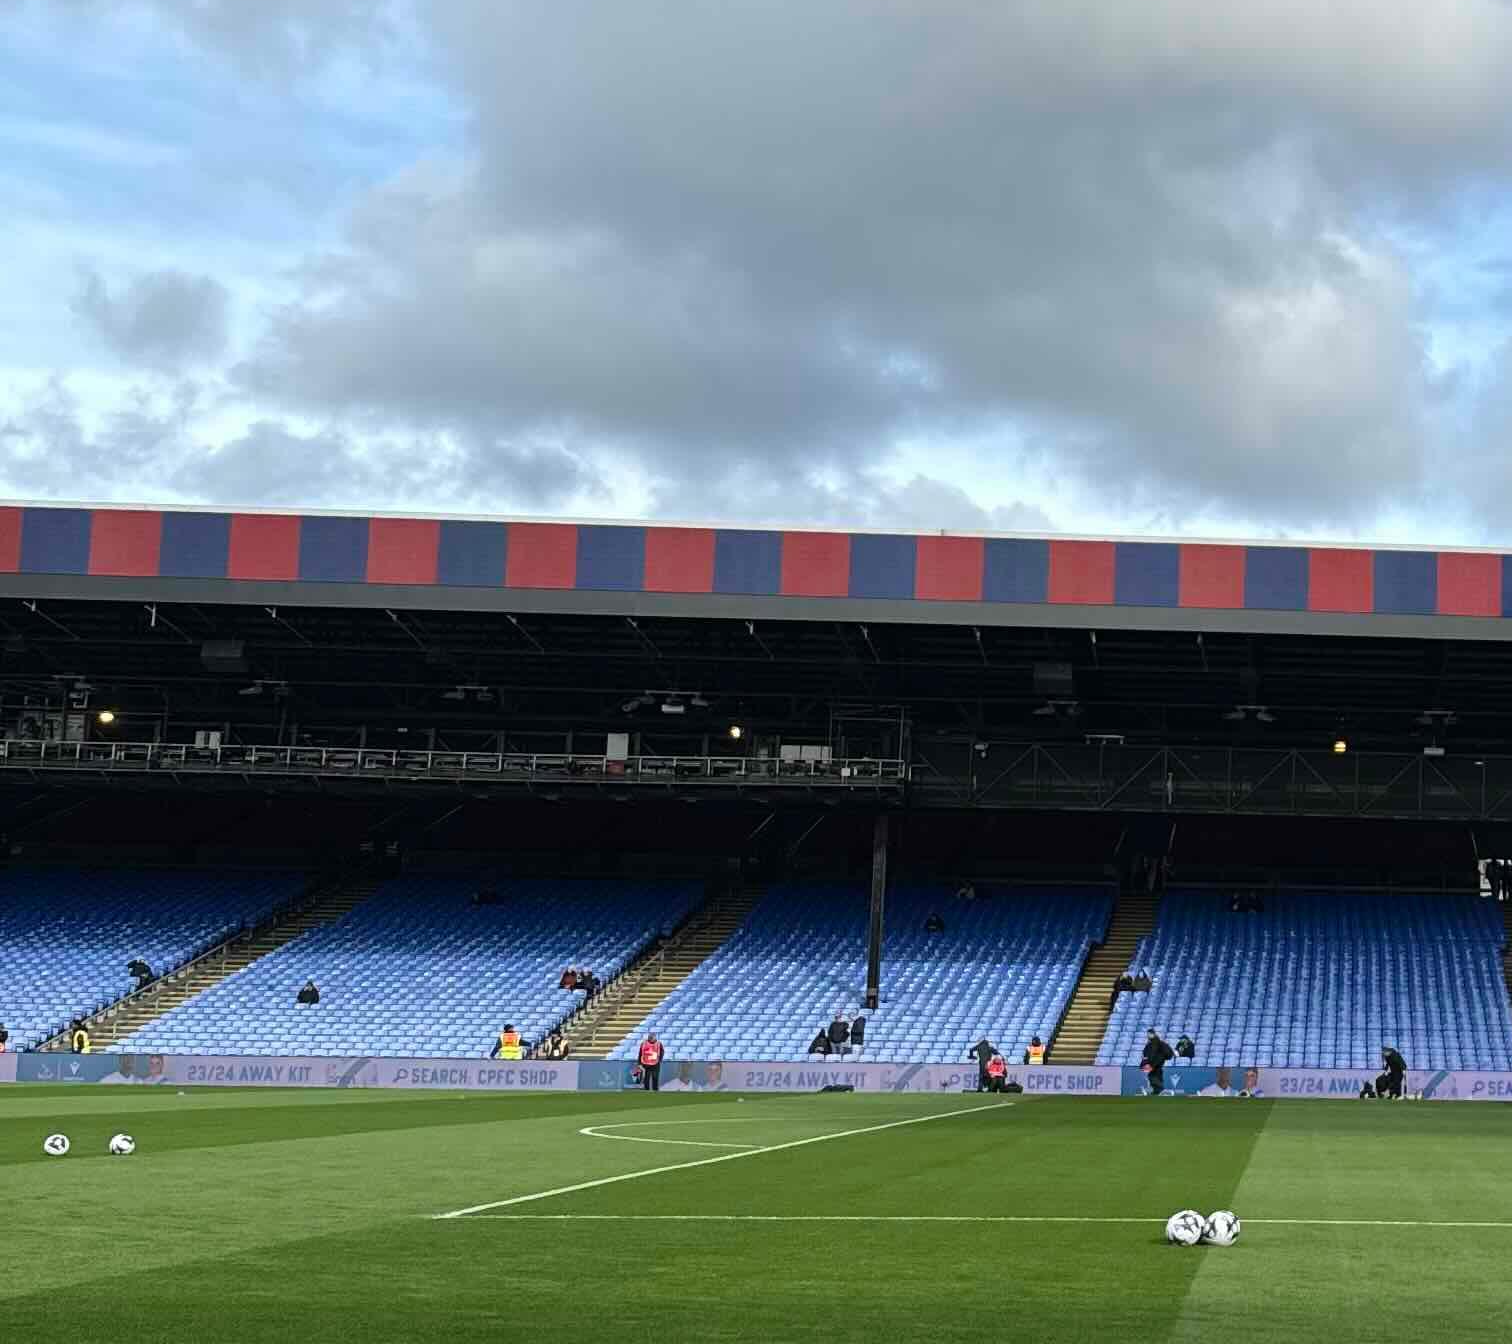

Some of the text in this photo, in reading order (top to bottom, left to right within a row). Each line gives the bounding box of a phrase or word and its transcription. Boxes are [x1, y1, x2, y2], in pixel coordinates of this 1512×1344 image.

[186, 1064, 313, 1082] 23/24 AWAY KIT
[477, 1068, 514, 1085] CPFC
[519, 1069, 559, 1086] SHOP
[745, 1071, 792, 1087] 23/24
[798, 1072, 839, 1087] AWAY
[1027, 1073, 1062, 1089] CPFC
[1067, 1074, 1103, 1090] SHOP
[1279, 1076, 1324, 1093] 23/24
